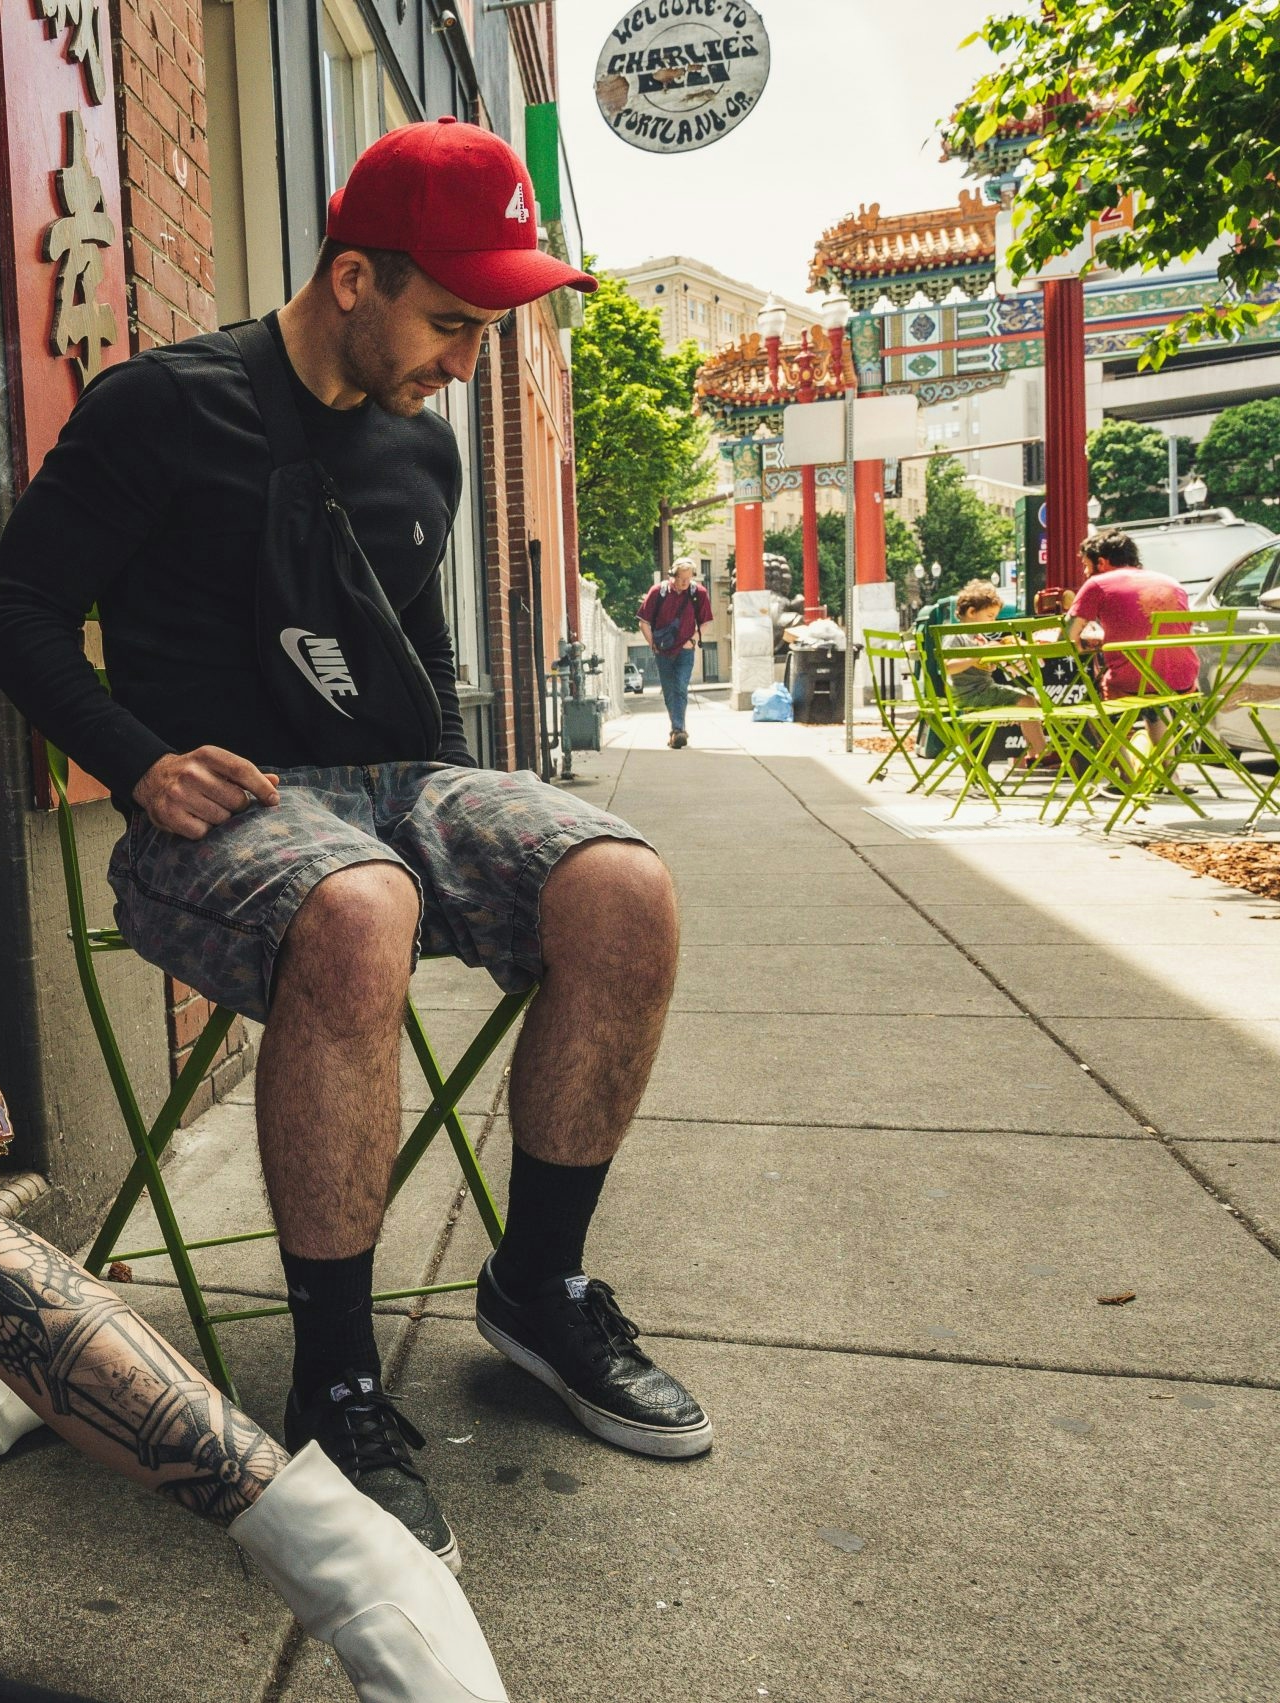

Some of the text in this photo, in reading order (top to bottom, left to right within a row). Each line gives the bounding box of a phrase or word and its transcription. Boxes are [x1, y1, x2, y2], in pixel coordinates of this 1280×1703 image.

[612, 0, 716, 45] WELCOME
[613, 108, 726, 145] PORTLAND
[504, 182, 530, 224] 4
[304, 638, 359, 698] NIKE
